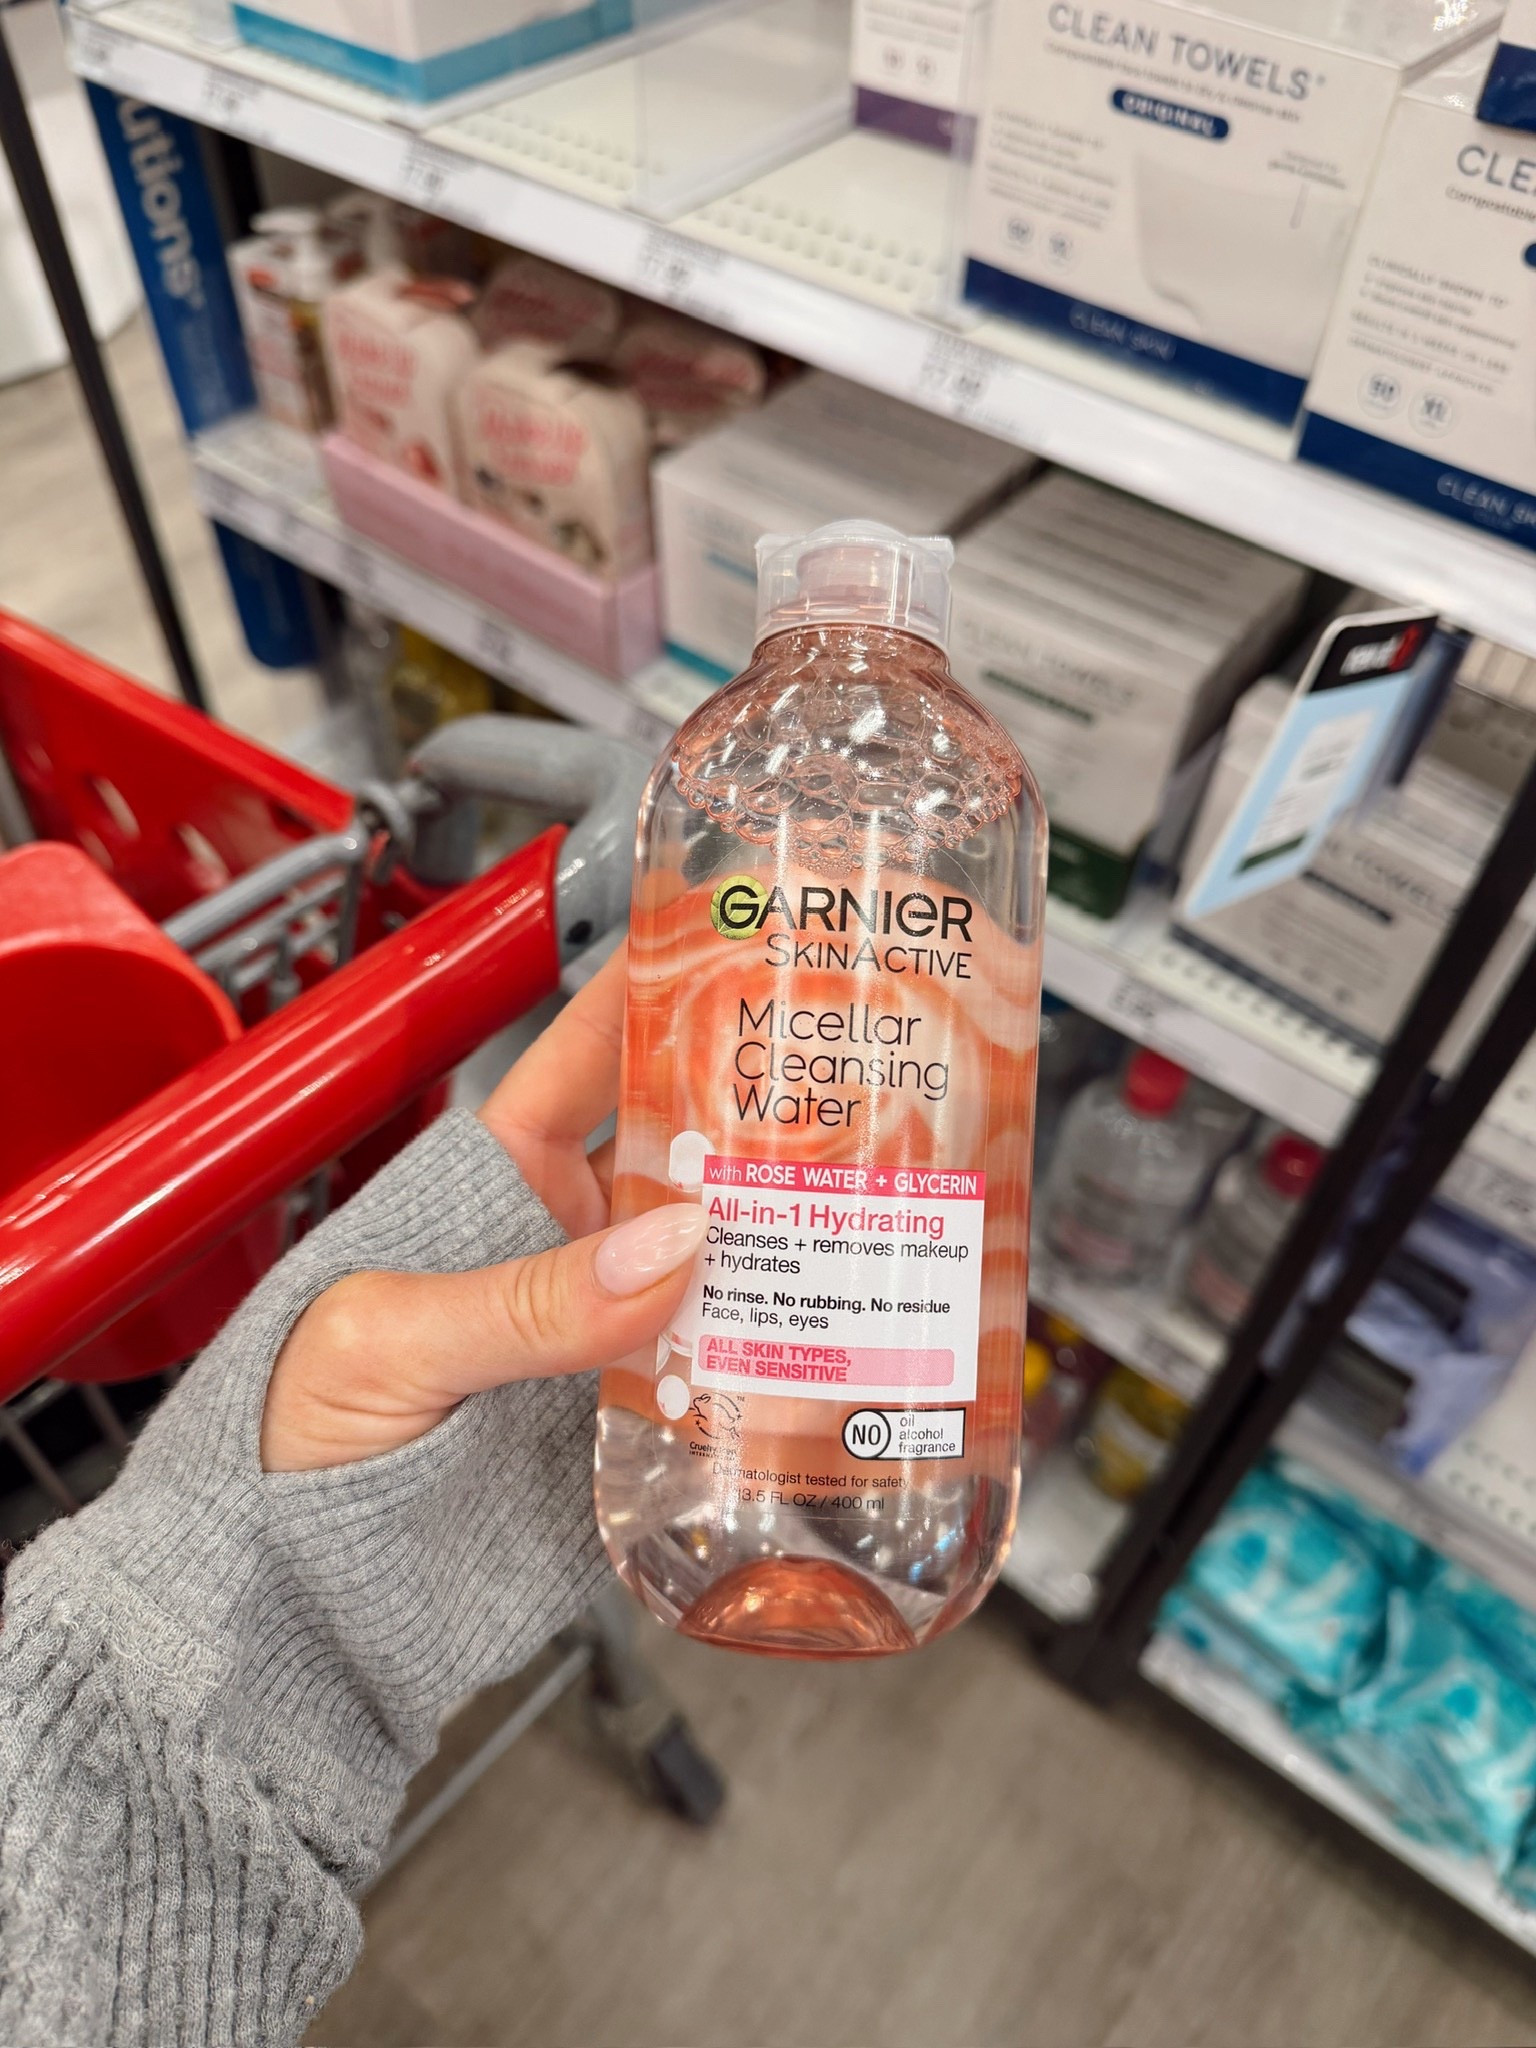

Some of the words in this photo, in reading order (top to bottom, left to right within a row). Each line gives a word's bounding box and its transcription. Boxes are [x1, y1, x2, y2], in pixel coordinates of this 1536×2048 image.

[1047, 3, 1159, 57] CLEAN
[1456, 144, 1536, 196] CLE
[738, 998, 922, 1046] Micellar
[734, 1041, 949, 1101] Cleansing
[732, 1083, 863, 1127] Water
[709, 1165, 742, 1182] with
[746, 1163, 796, 1186] ROSE
[802, 1166, 867, 1190] WATER
[876, 1176, 888, 1188] +
[894, 1172, 977, 1196] GLYCERIN
[708, 1196, 800, 1227] All-in-1
[809, 1204, 945, 1240] Hydrating
[706, 1225, 788, 1251] Cleanses
[794, 1239, 807, 1252] +
[813, 1238, 895, 1257] removes
[901, 1239, 969, 1262] makeup
[704, 1253, 716, 1267] +
[721, 1251, 801, 1275] hydrates
[703, 1285, 724, 1301] No
[727, 1288, 769, 1306] rinse.
[773, 1291, 796, 1308] No
[800, 1294, 866, 1315] rubbing.
[871, 1297, 893, 1312] No
[897, 1298, 950, 1314] residue
[701, 1302, 744, 1324] Face,
[749, 1304, 783, 1329] lips,
[788, 1312, 829, 1330] eyes
[706, 1337, 738, 1355] ALL
[741, 1340, 784, 1360] SKIN
[788, 1344, 852, 1367] TYPES,
[706, 1354, 750, 1373] EVEN
[755, 1360, 847, 1383] SENSITIVE
[851, 1423, 881, 1447] NO
[899, 1415, 915, 1428] oil
[899, 1427, 944, 1441] alcohol
[898, 1440, 956, 1455] fragrance
[805, 1472, 847, 1487] tested
[850, 1475, 868, 1488] for
[871, 1476, 909, 1491] safety
[770, 1491, 789, 1505] FL
[793, 1493, 817, 1507] OZ
[819, 1495, 829, 1509] /
[831, 1496, 862, 1510] 400
[866, 1497, 885, 1510] ml
